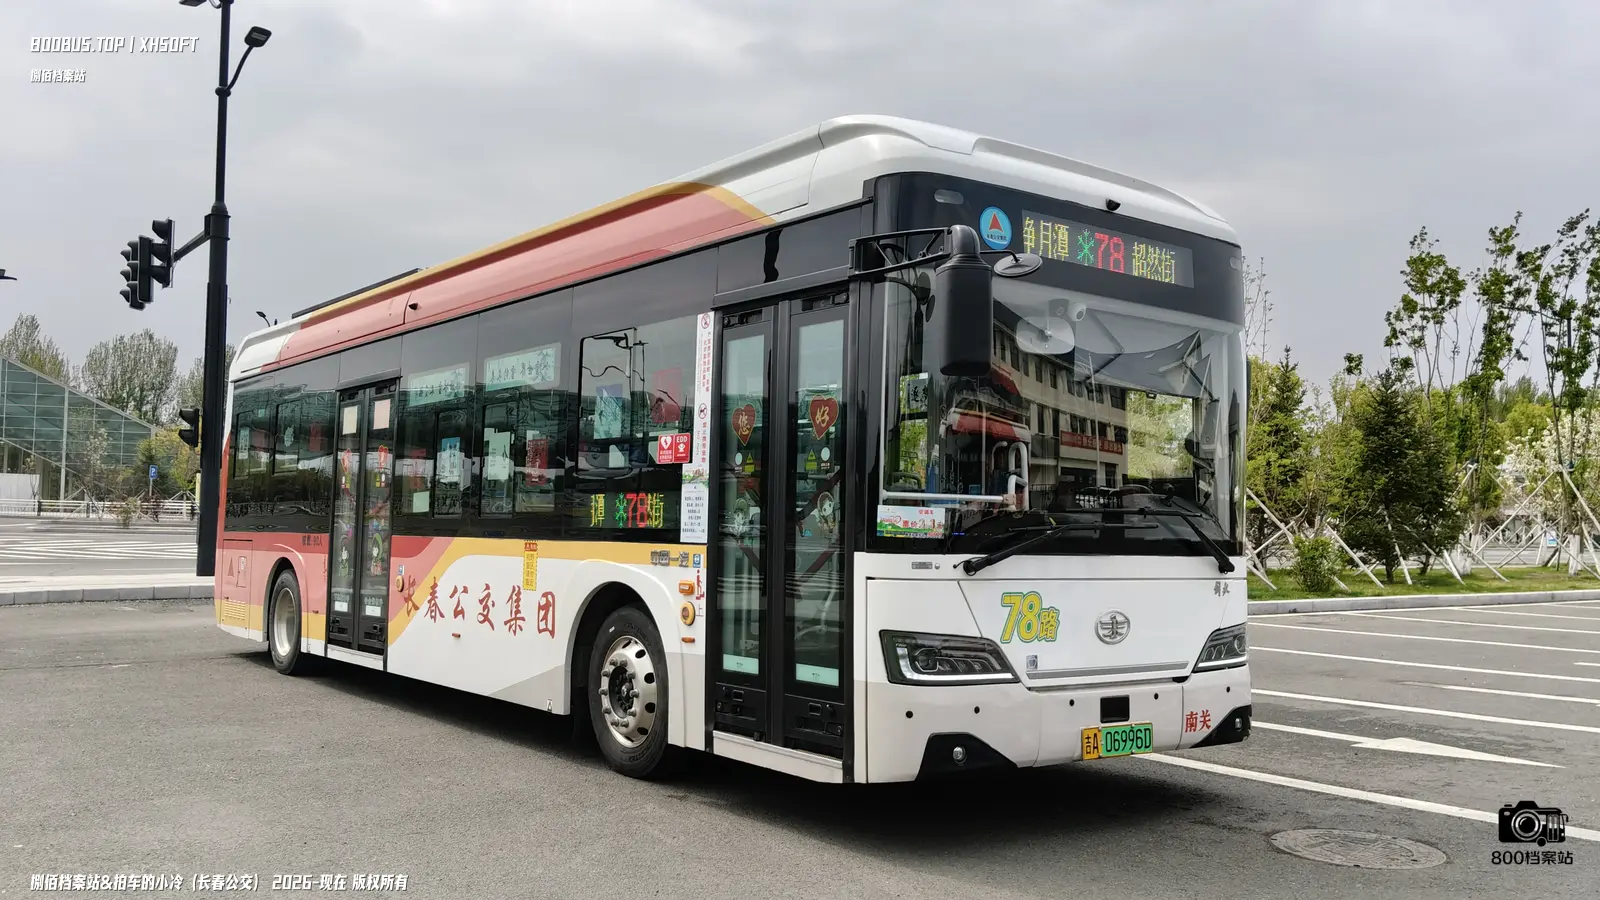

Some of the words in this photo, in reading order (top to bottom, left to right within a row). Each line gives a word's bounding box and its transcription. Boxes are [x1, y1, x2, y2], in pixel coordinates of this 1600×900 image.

[1095, 232, 1125, 274] 78
[1132, 242, 1176, 284] 超然街
[737, 411, 751, 436] 您
[815, 404, 831, 428] 好
[625, 492, 648, 528] 78
[403, 574, 556, 640] 长春公交集团
[1000, 591, 1060, 644] 78路
[1184, 709, 1212, 733] 南关
[1085, 732, 1100, 755] 吉A
[1105, 727, 1152, 753] 06996D
